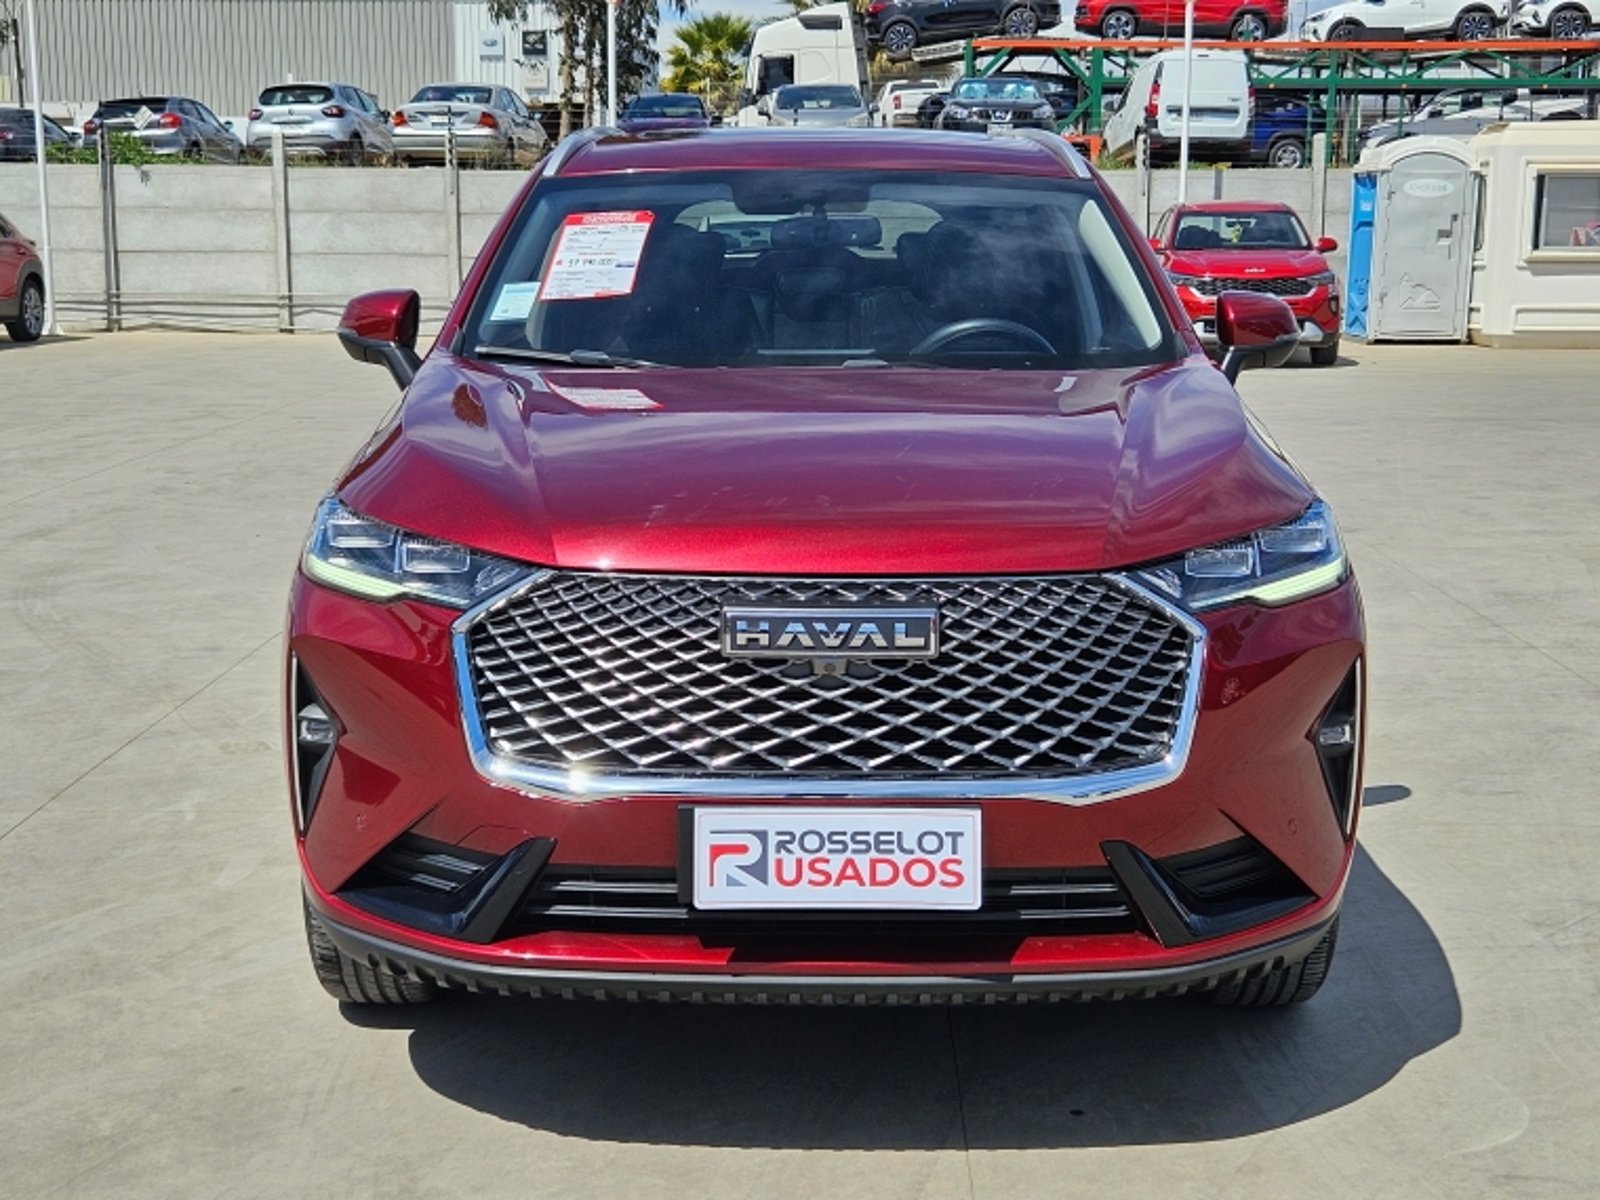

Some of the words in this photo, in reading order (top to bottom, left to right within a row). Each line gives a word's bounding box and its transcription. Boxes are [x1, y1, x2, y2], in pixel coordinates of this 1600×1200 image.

[735, 620, 926, 649] HAVAL
[774, 829, 965, 856] ROSSELOT
[774, 857, 965, 888] USADOS
